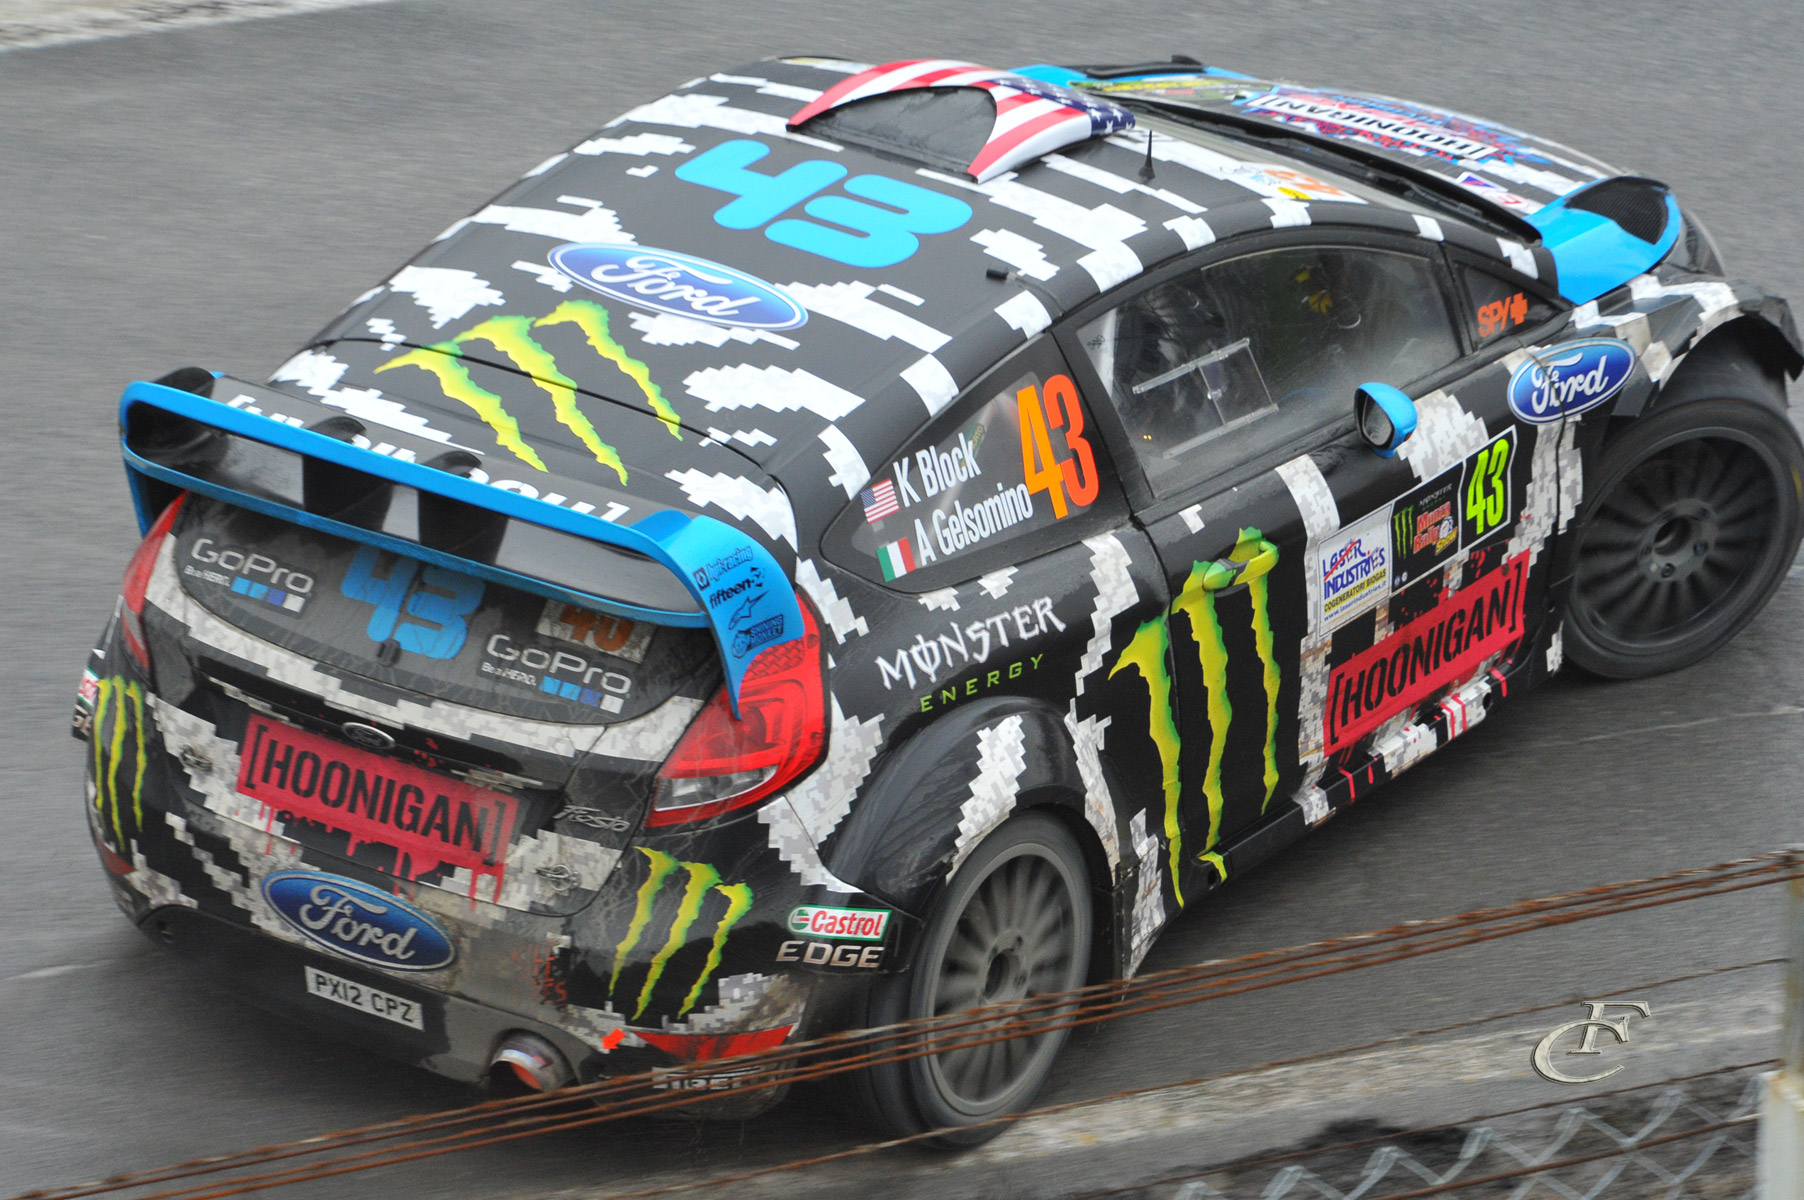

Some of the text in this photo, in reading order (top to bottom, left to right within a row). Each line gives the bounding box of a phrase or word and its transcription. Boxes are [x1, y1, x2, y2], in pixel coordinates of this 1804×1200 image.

[675, 139, 972, 267] 43
[591, 254, 763, 320] Ford
[1531, 352, 1609, 414] Ford
[893, 432, 982, 507] K Block
[1017, 374, 1099, 519] 43
[1466, 439, 1509, 535] 43
[914, 482, 1034, 566] A Gelsomino
[191, 538, 314, 593] GoPro
[1322, 538, 1366, 576] LASER
[1324, 547, 1386, 600] INDUSTRIES
[340, 544, 486, 660] 43
[1324, 568, 1387, 612] COGENERATORI BIOGAS
[486, 634, 632, 694] GoPro
[920, 654, 1043, 712] ENERGY
[552, 805, 631, 833] Fiesta
[299, 883, 418, 963] Ford
[811, 910, 883, 936] Castrol
[776, 940, 885, 968] EDGE
[314, 973, 413, 1023] PX12 CPZ
